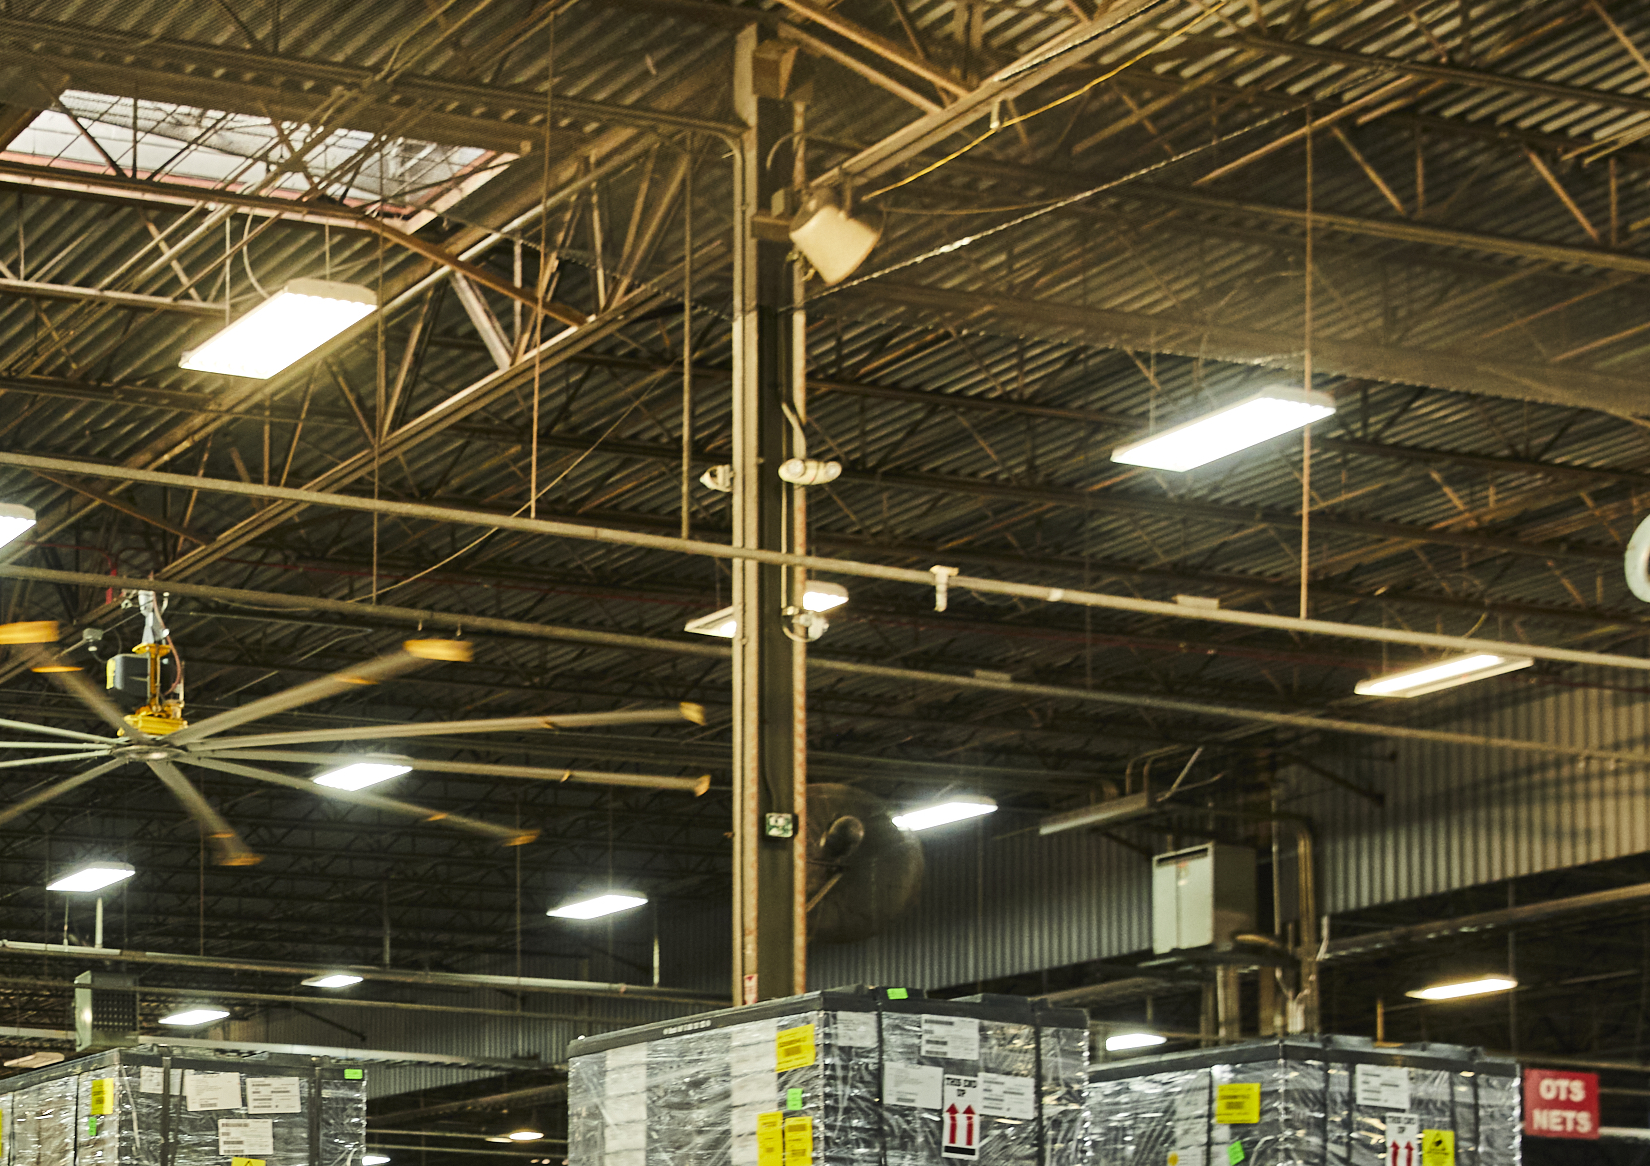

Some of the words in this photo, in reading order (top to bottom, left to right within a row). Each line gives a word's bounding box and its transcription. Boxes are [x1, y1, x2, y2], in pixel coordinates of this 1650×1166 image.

[946, 1077, 962, 1087] THIS
[963, 1079, 978, 1088] END
[1539, 1079, 1586, 1102] OTS
[957, 1088, 967, 1097] UP
[1532, 1109, 1593, 1133] NETS
